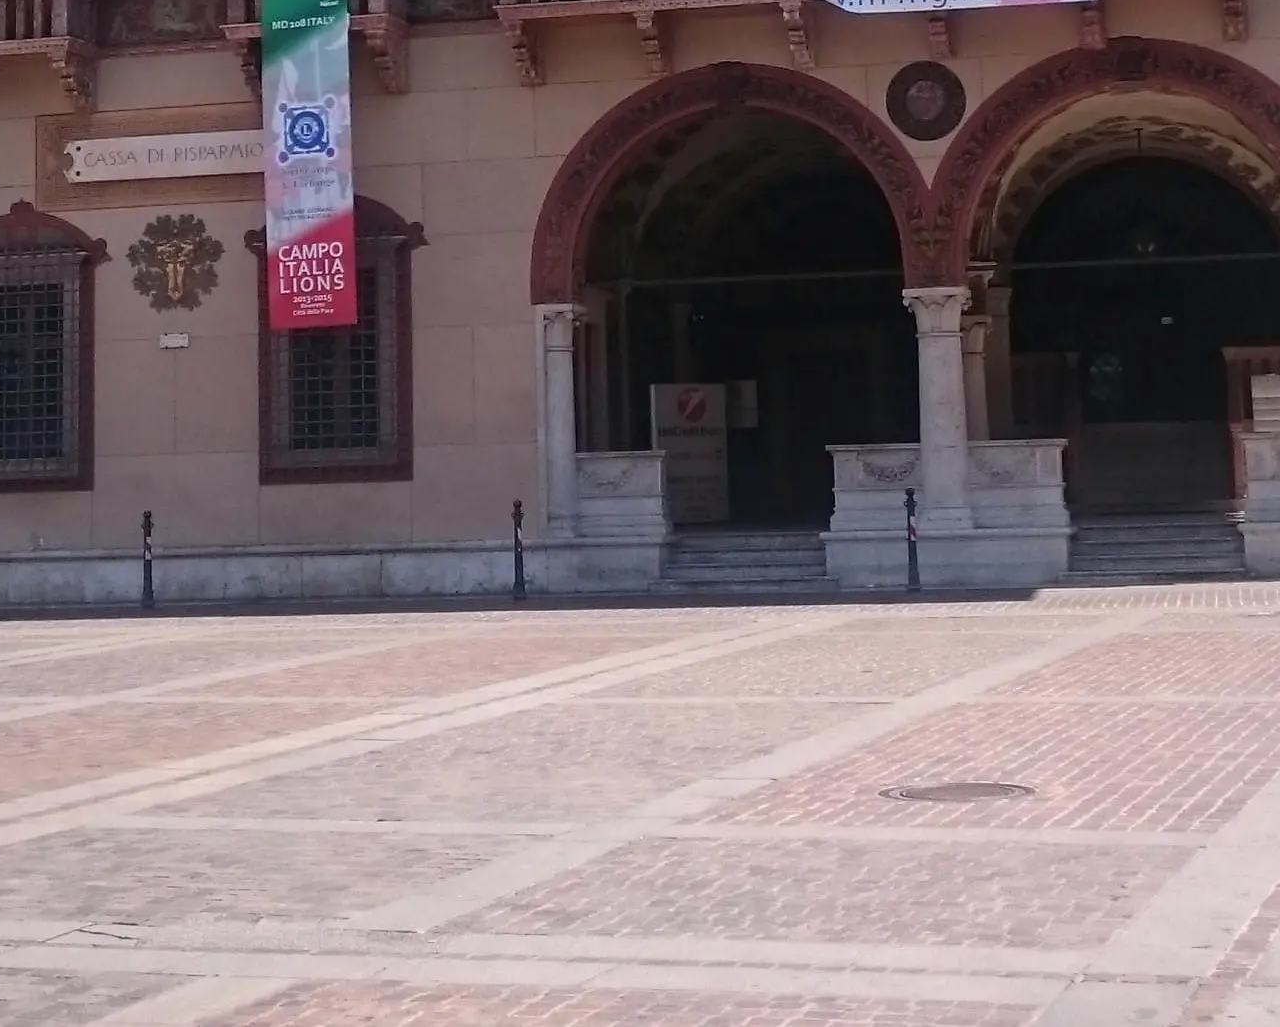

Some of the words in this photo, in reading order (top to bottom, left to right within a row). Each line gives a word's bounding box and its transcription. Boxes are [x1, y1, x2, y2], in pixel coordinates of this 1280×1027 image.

[307, 16, 336, 27] ITALY
[83, 149, 138, 168] CASSA
[147, 148, 165, 165] DI
[173, 141, 265, 162] RISPARMIO
[278, 241, 344, 262] CAMPO
[279, 258, 345, 278] ITALIA
[279, 274, 345, 294] LIONS
